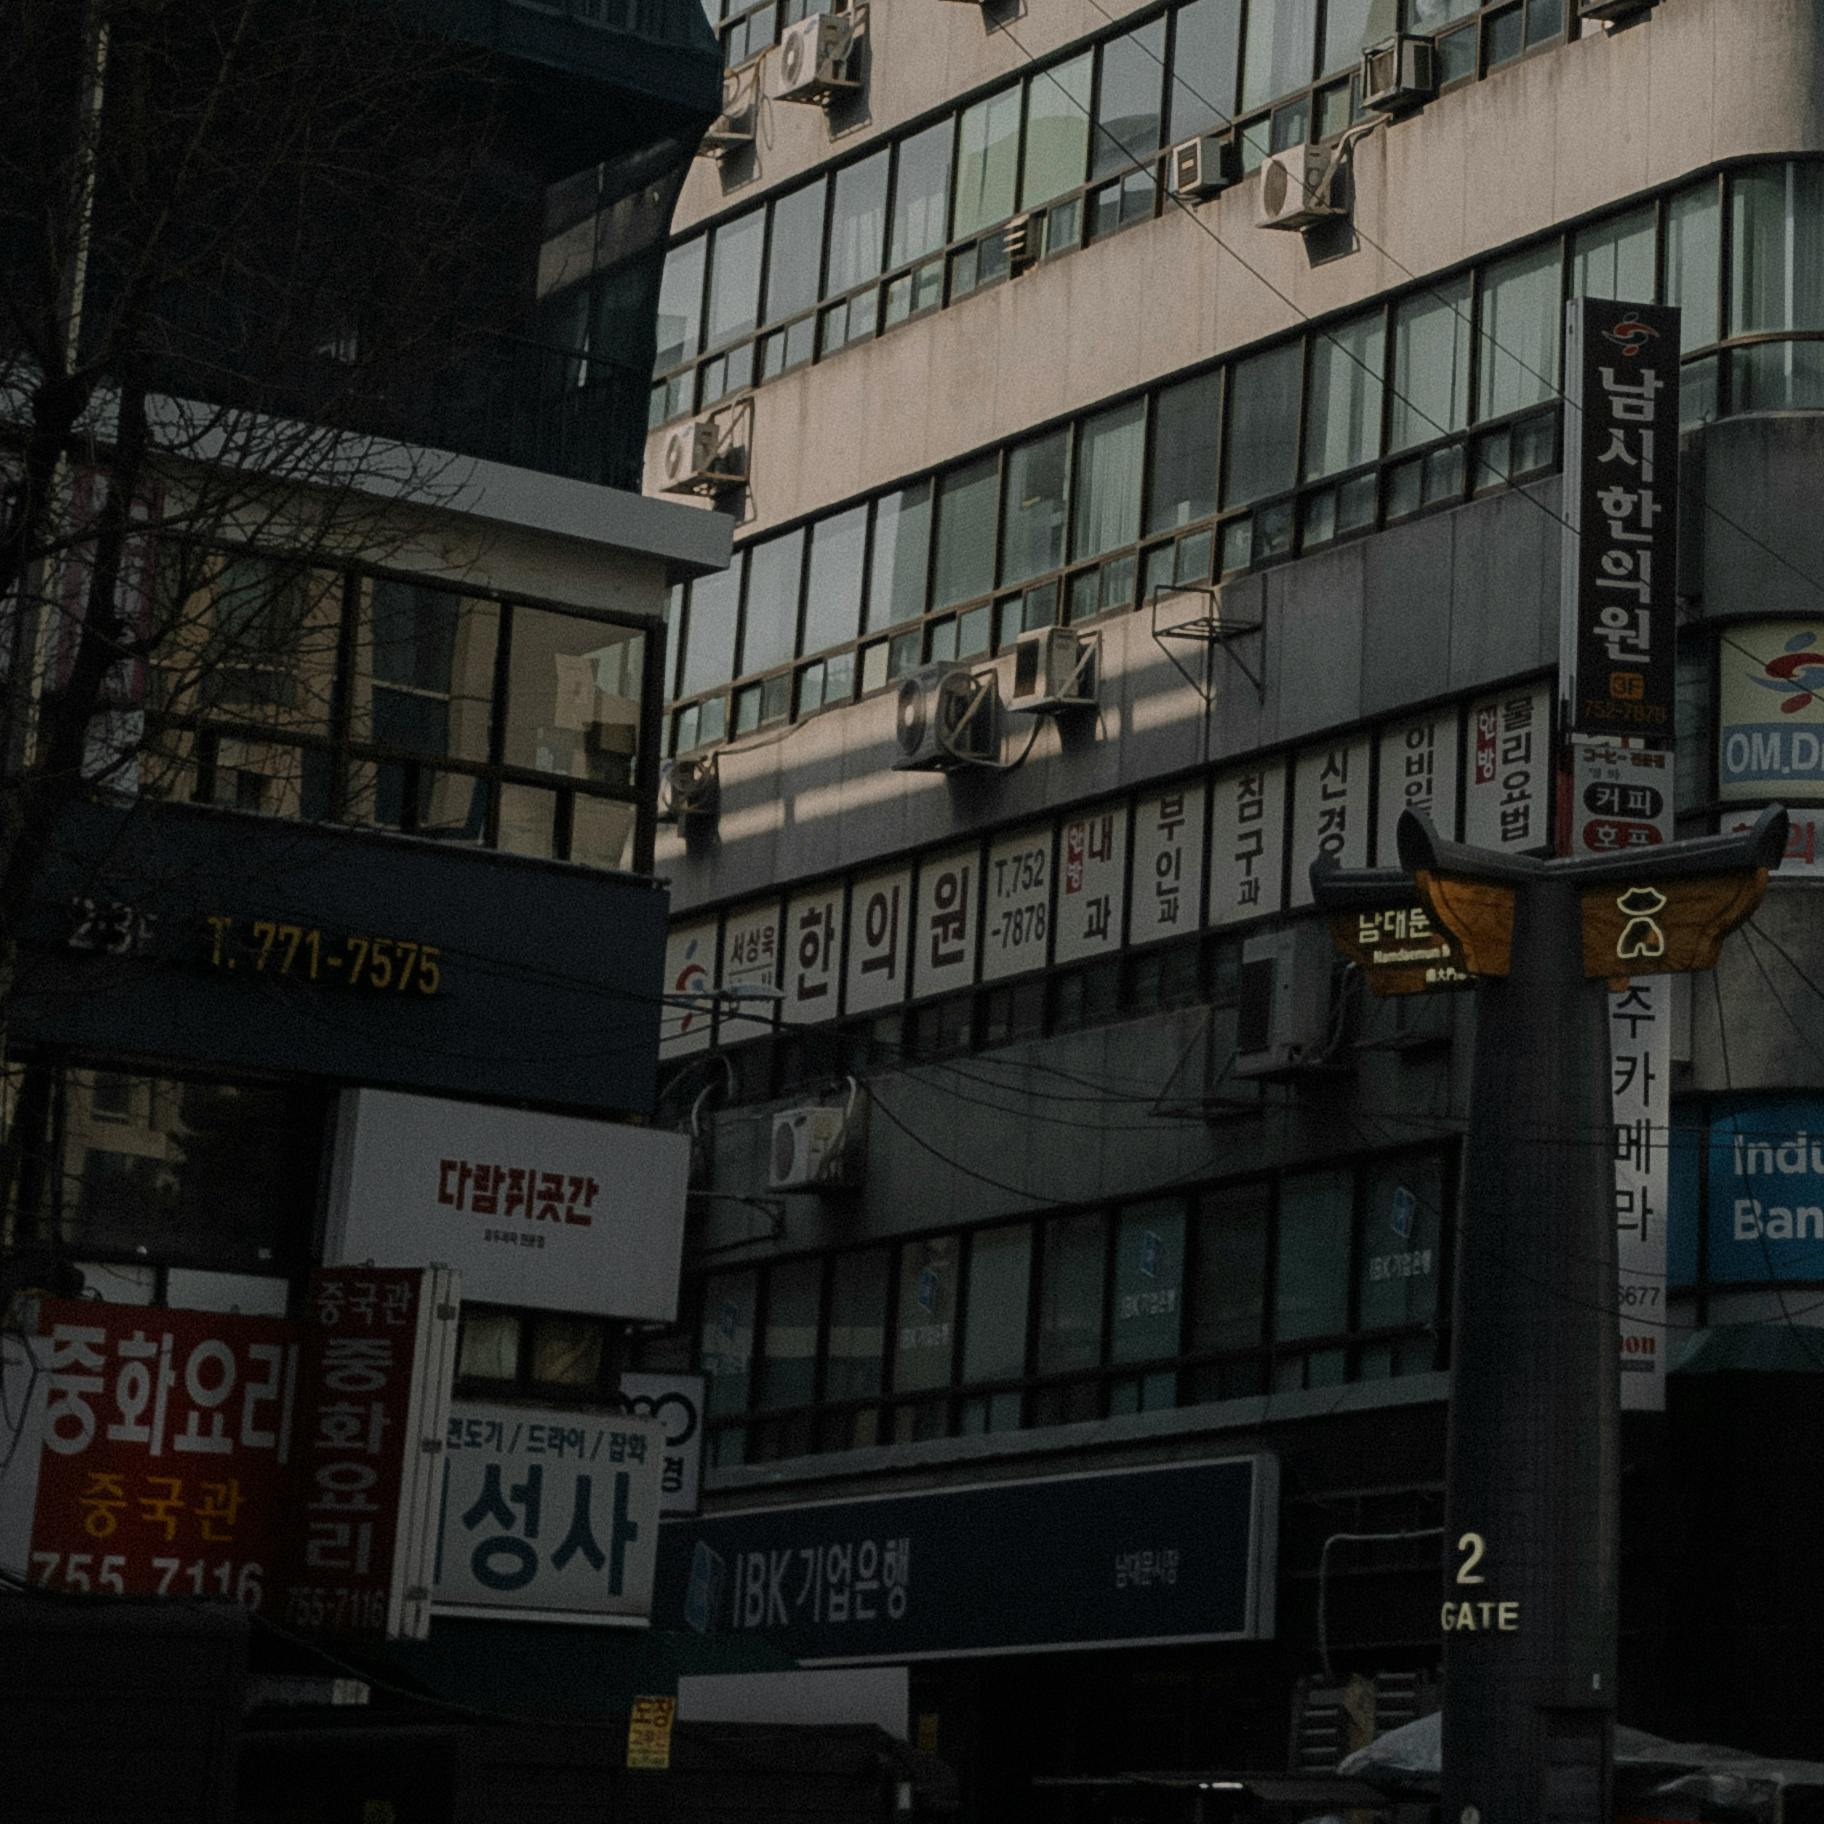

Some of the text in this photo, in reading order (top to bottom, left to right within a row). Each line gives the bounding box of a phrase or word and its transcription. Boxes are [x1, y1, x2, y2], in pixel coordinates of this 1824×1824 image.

[1592, 364, 1664, 664] 남시한의원
[1317, 745, 1350, 863] 신경
[1404, 725, 1435, 812] 이비인
[1499, 695, 1535, 844] 물리요법
[1594, 786, 1653, 816] 커피
[1156, 794, 1187, 925] 부인과
[1236, 769, 1266, 908] 침구과
[249, 919, 444, 997] 771-7575
[437, 1158, 600, 1228] 다람쥐곳간
[316, 1280, 415, 1327] 중국관
[40, 1322, 300, 1465] 중화요리
[305, 1337, 394, 1576] 중화요리
[79, 1472, 247, 1544] 중국관
[437, 1457, 639, 1597] 성사
[1455, 1532, 1486, 1585] 2
[1440, 1600, 1520, 1633] GATE
